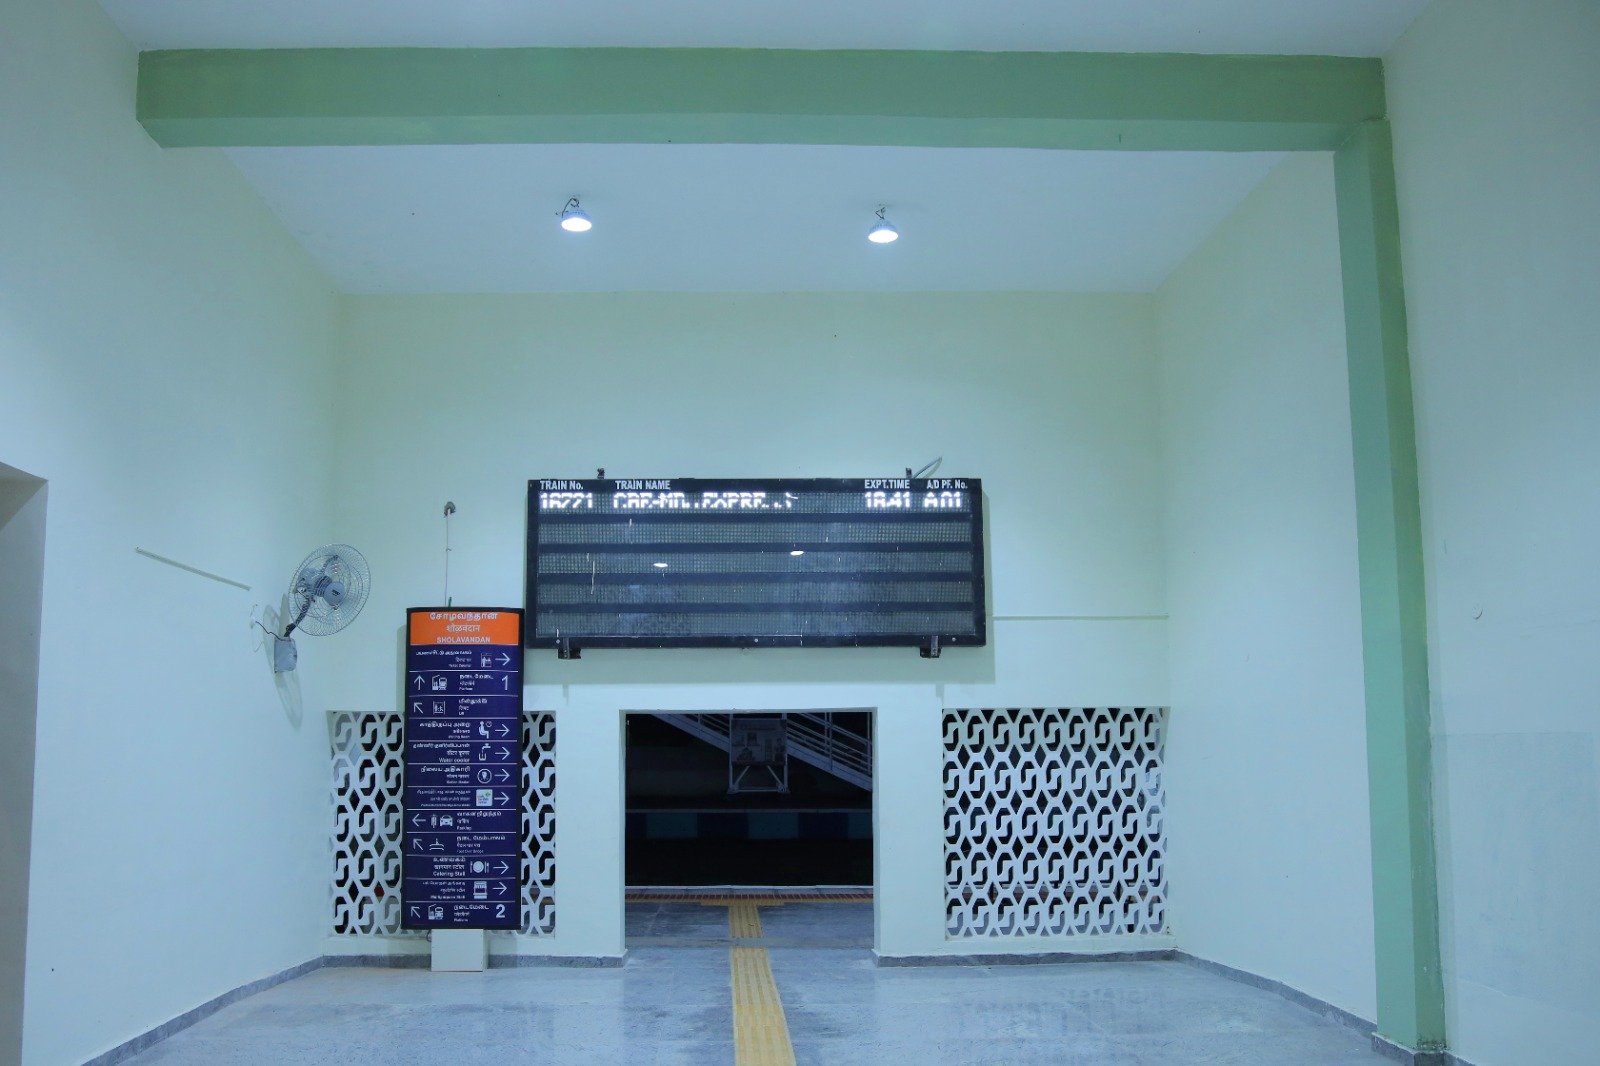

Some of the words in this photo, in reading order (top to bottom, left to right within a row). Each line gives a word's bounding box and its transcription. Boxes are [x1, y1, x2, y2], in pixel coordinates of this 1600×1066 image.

[540, 480, 567, 490] TRAIN
[570, 480, 584, 490] No.
[615, 480, 642, 490] TRAIN
[645, 480, 670, 490] NAME
[955, 479, 968, 489] No.
[502, 674, 509, 691] 1
[496, 903, 506, 919] 2
